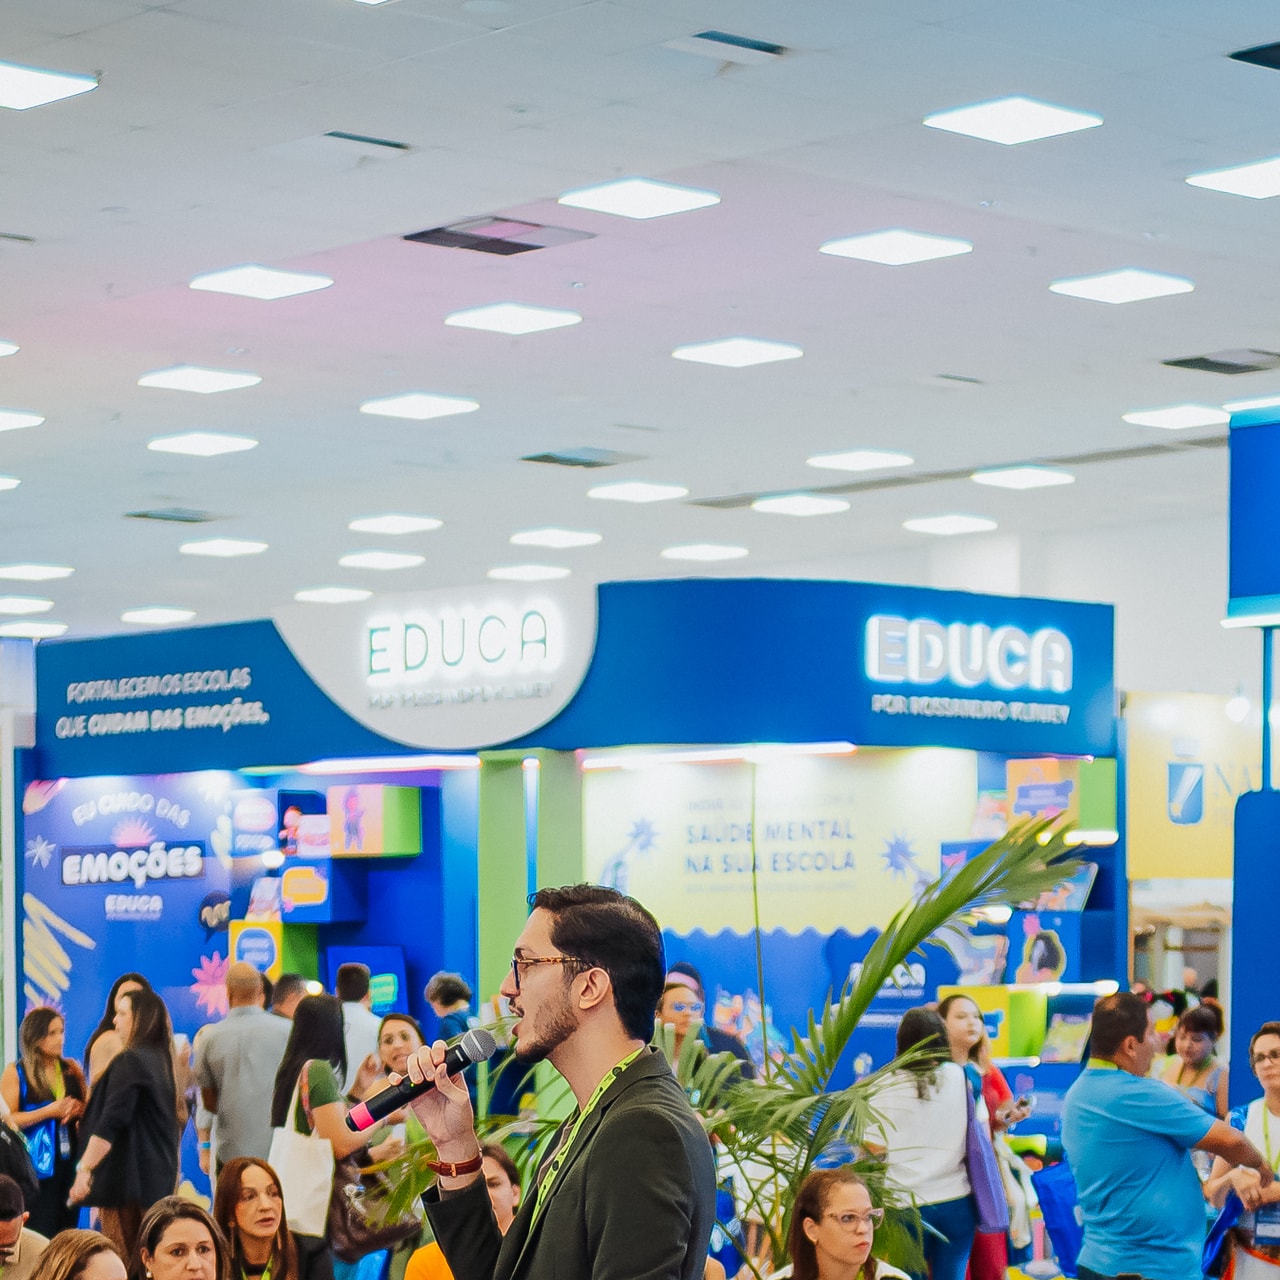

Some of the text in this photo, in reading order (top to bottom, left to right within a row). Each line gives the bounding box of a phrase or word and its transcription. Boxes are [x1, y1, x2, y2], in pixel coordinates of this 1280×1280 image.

[367, 608, 549, 677] EDUCA
[866, 614, 1073, 693] EDUCA
[183, 667, 252, 694] ESCOLAS
[56, 715, 88, 739] QUE
[150, 707, 184, 732] DAS
[156, 798, 192, 829] DAS
[765, 819, 855, 842] MENTAL
[62, 841, 203, 889] EMOÇÕES
[686, 849, 856, 874] NA SUA ESCOLA
[104, 894, 163, 913] EDUCA
